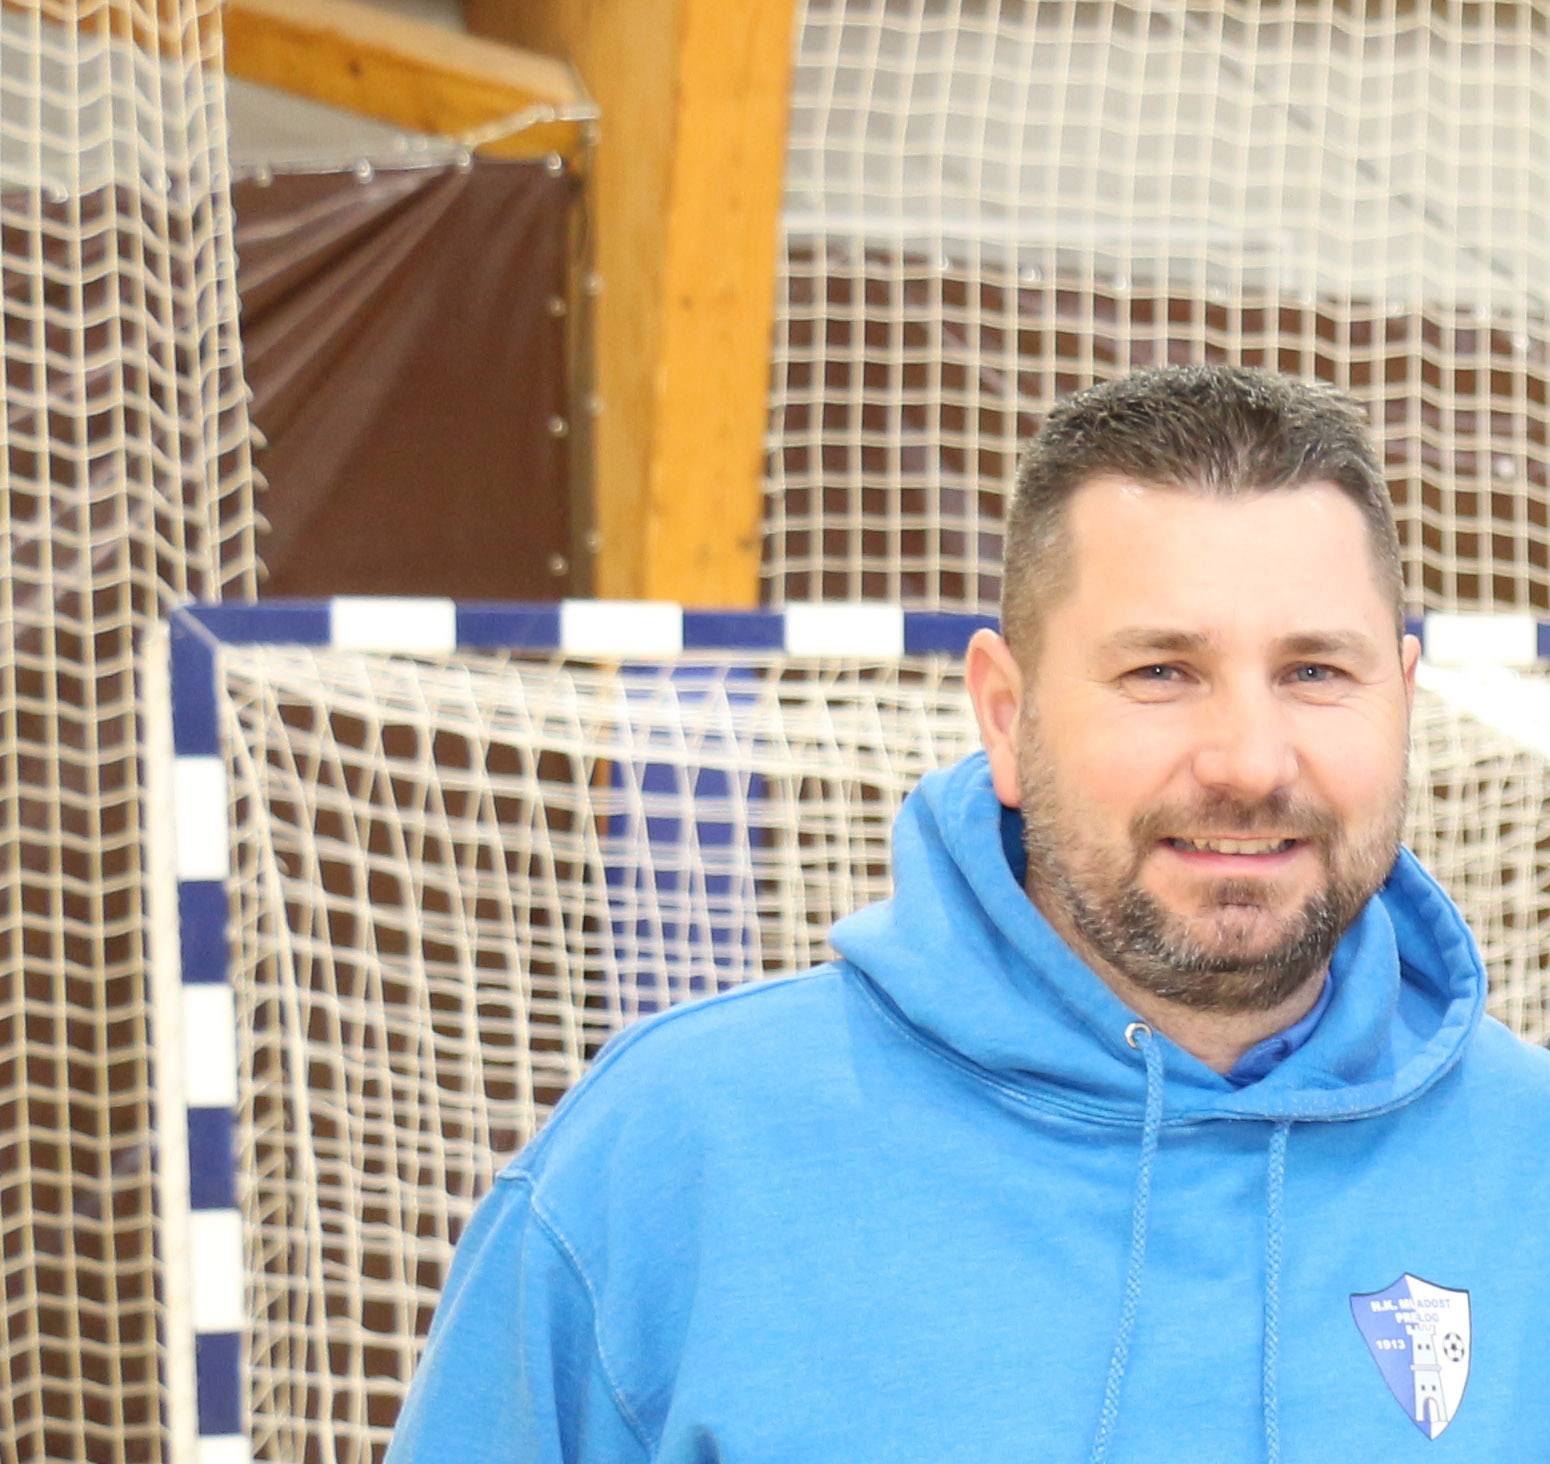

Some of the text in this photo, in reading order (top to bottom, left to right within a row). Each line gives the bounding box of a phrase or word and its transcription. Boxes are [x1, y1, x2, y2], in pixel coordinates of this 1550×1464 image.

[1370, 1299, 1398, 1312] N.K.
[1395, 1312, 1439, 1323] PRELOG
[1375, 1338, 1406, 1350] 1913
